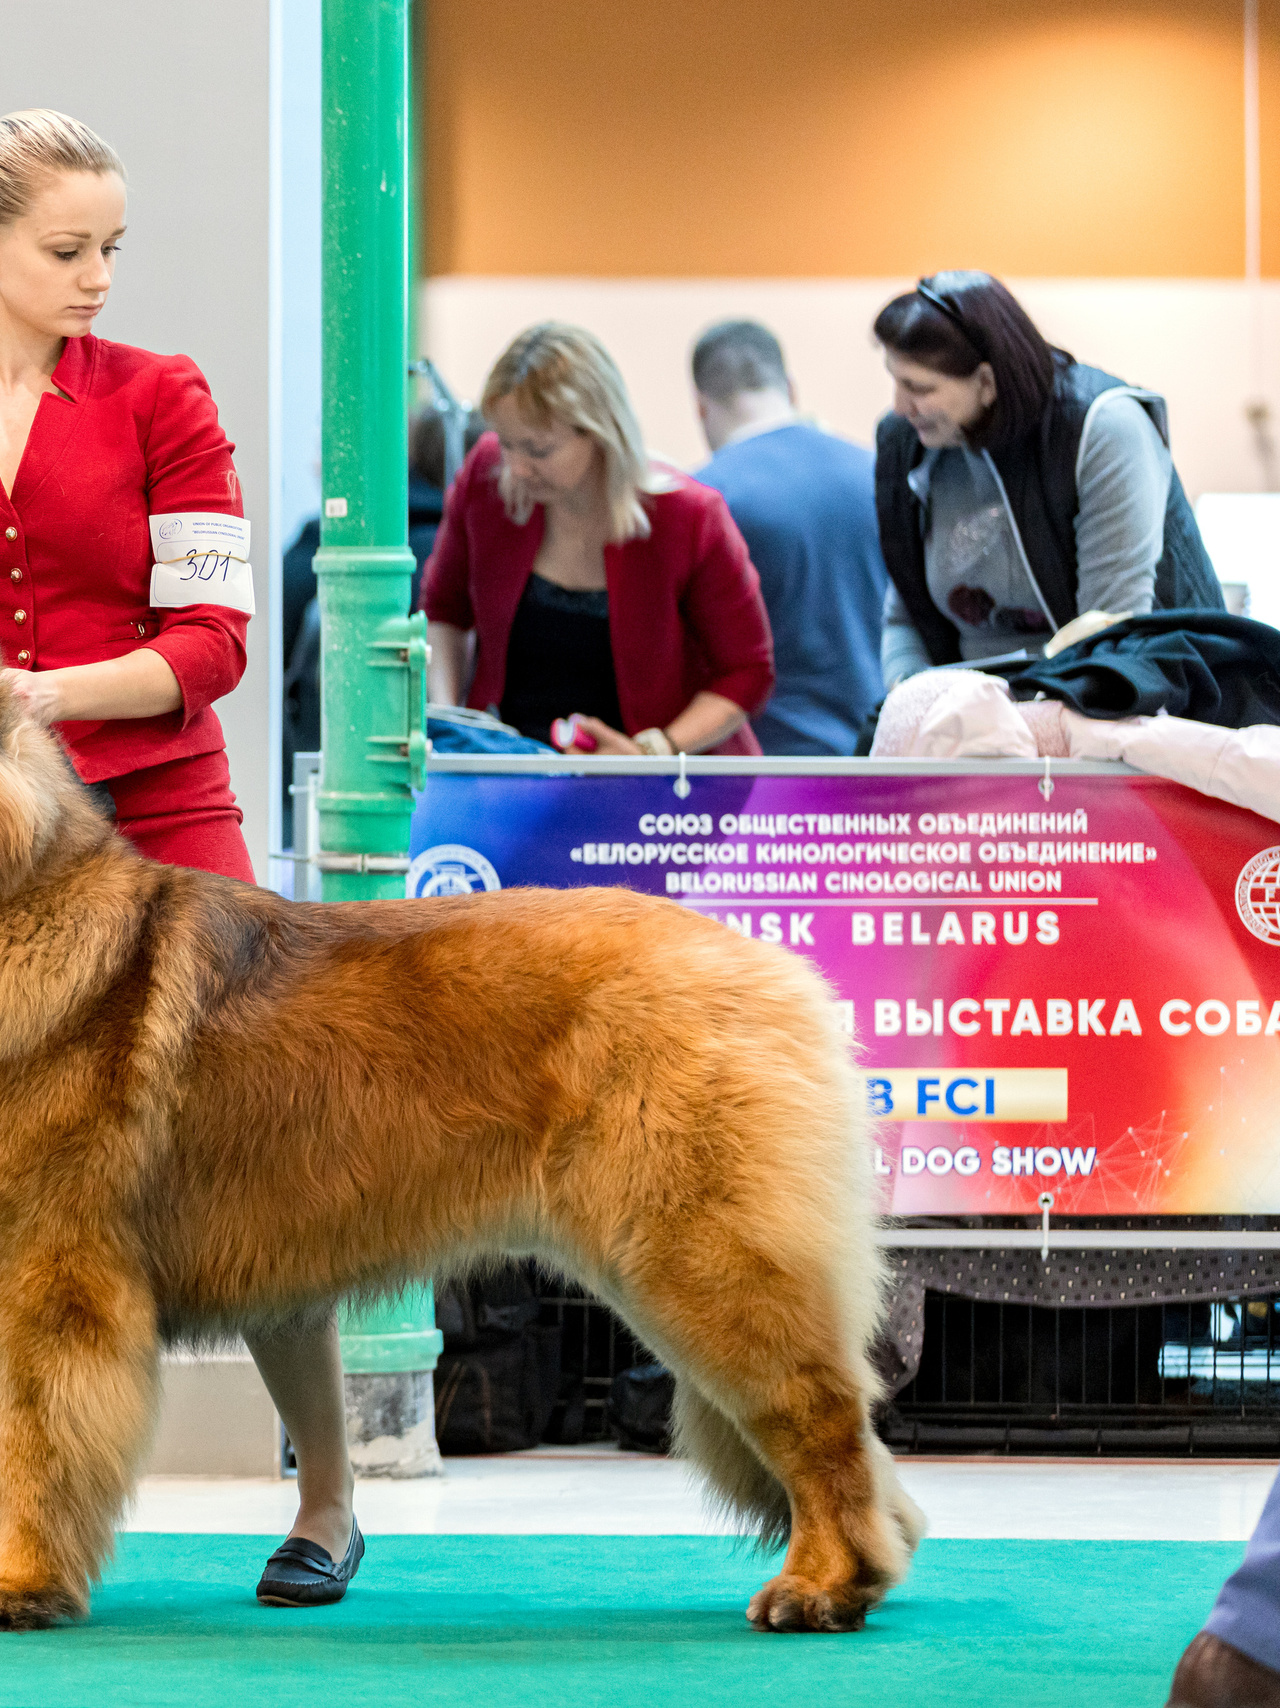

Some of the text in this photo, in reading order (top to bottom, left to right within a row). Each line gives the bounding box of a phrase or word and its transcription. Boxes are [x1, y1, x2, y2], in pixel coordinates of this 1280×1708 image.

[180, 549, 231, 581] 301
[639, 808, 1088, 838] СОЮЗ ОБЩЕСТВЕННЫХ ОБЪЕДИНЕНИЙ
[570, 841, 1157, 866] «БЕЛОРУССКОЕ КИНОЛОГИЧЕСКОЕ ОБЪЕДИНЕНИЕ»
[665, 871, 1062, 893] BELORUSSIAN CINOLOGICAL UNION
[708, 911, 1060, 945] NSK BELARUS
[874, 998, 1142, 1036] ВЫСТАВКА
[917, 1078, 995, 1116] FCI
[902, 1147, 980, 1177] DOG
[992, 1147, 1096, 1177] SHOW
